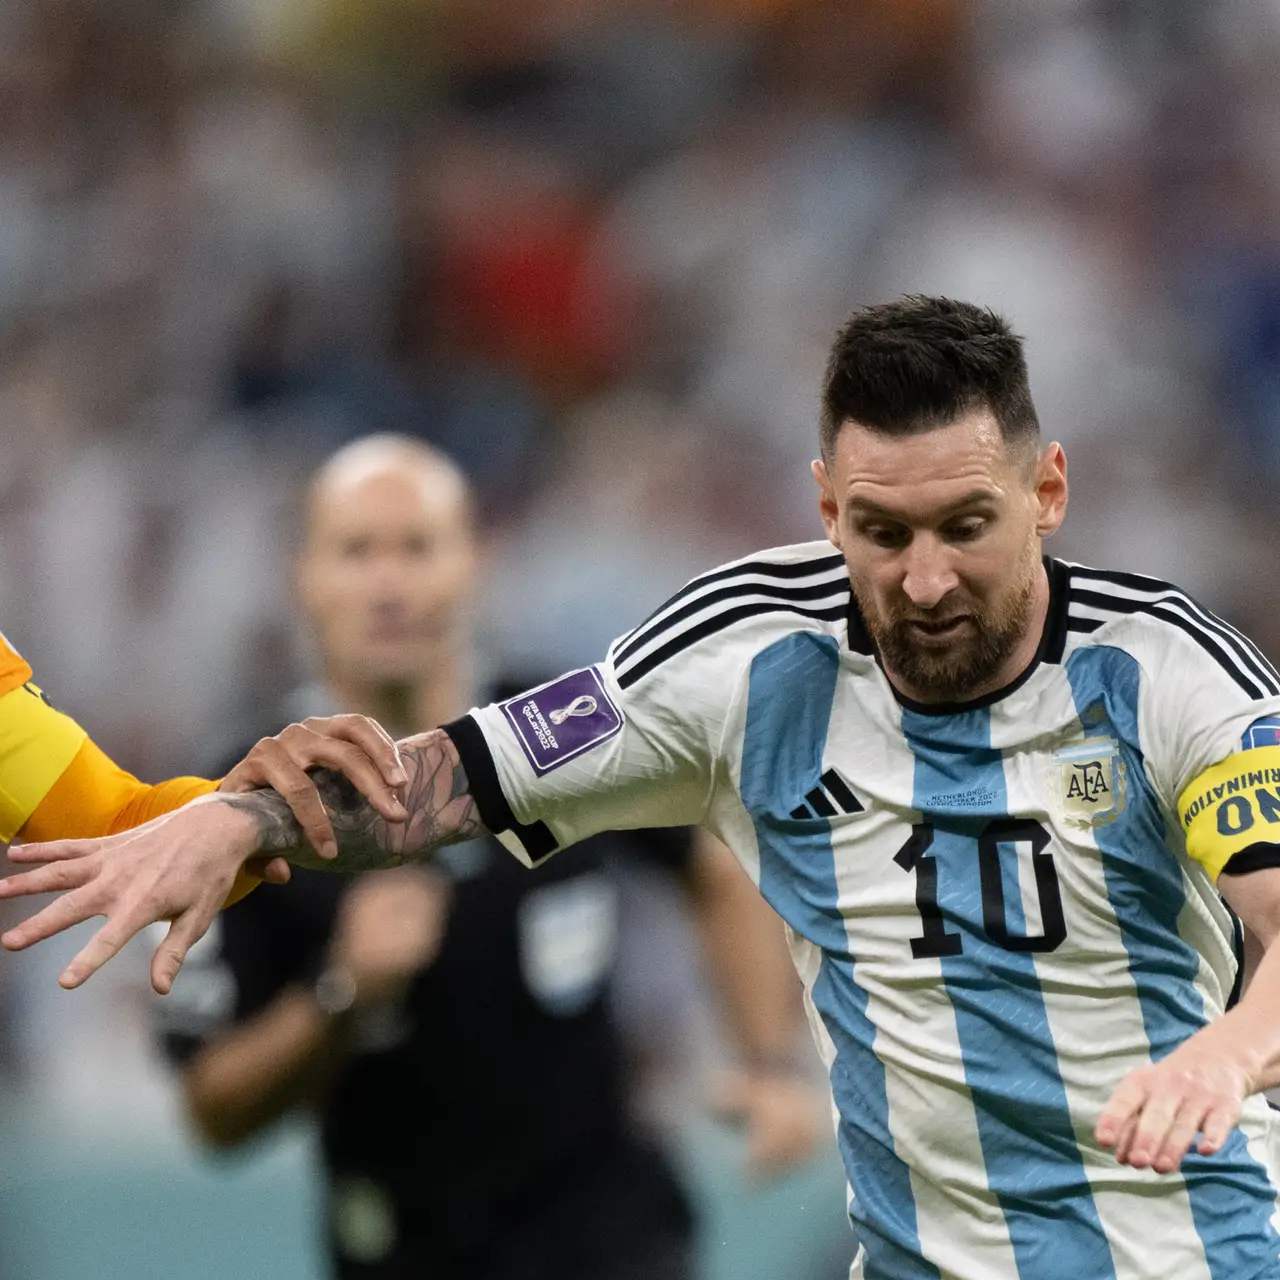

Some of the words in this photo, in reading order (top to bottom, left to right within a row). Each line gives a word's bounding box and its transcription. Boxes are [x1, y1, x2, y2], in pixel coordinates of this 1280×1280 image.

[528, 700, 539, 714] FIFA
[536, 712, 551, 736] WORLD
[548, 735, 559, 749] CUP
[931, 787, 987, 801] NETHERLANDS
[1067, 761, 1109, 803] AFA
[893, 818, 1067, 959] 10
